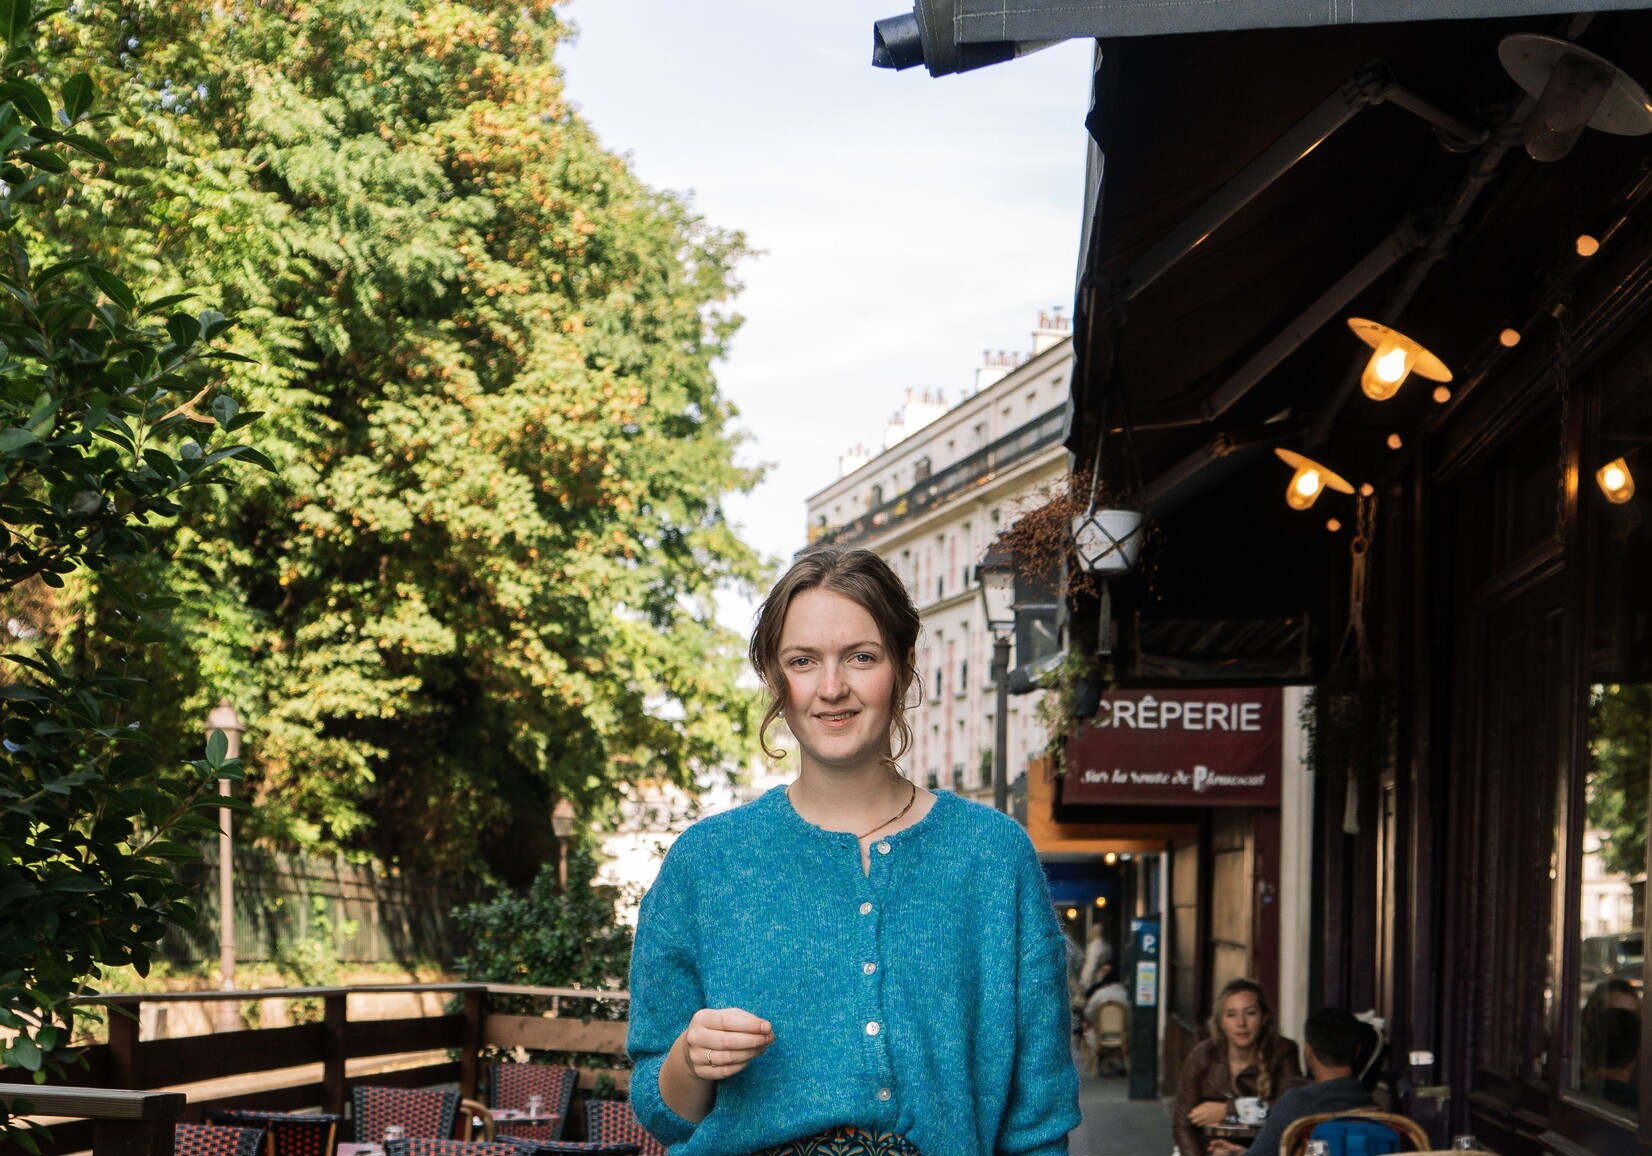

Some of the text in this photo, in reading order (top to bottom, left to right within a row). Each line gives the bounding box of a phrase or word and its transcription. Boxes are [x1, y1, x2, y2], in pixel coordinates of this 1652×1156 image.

[1081, 769, 1109, 784] Sur
[1111, 768, 1128, 784] la
[1171, 769, 1191, 785] de
